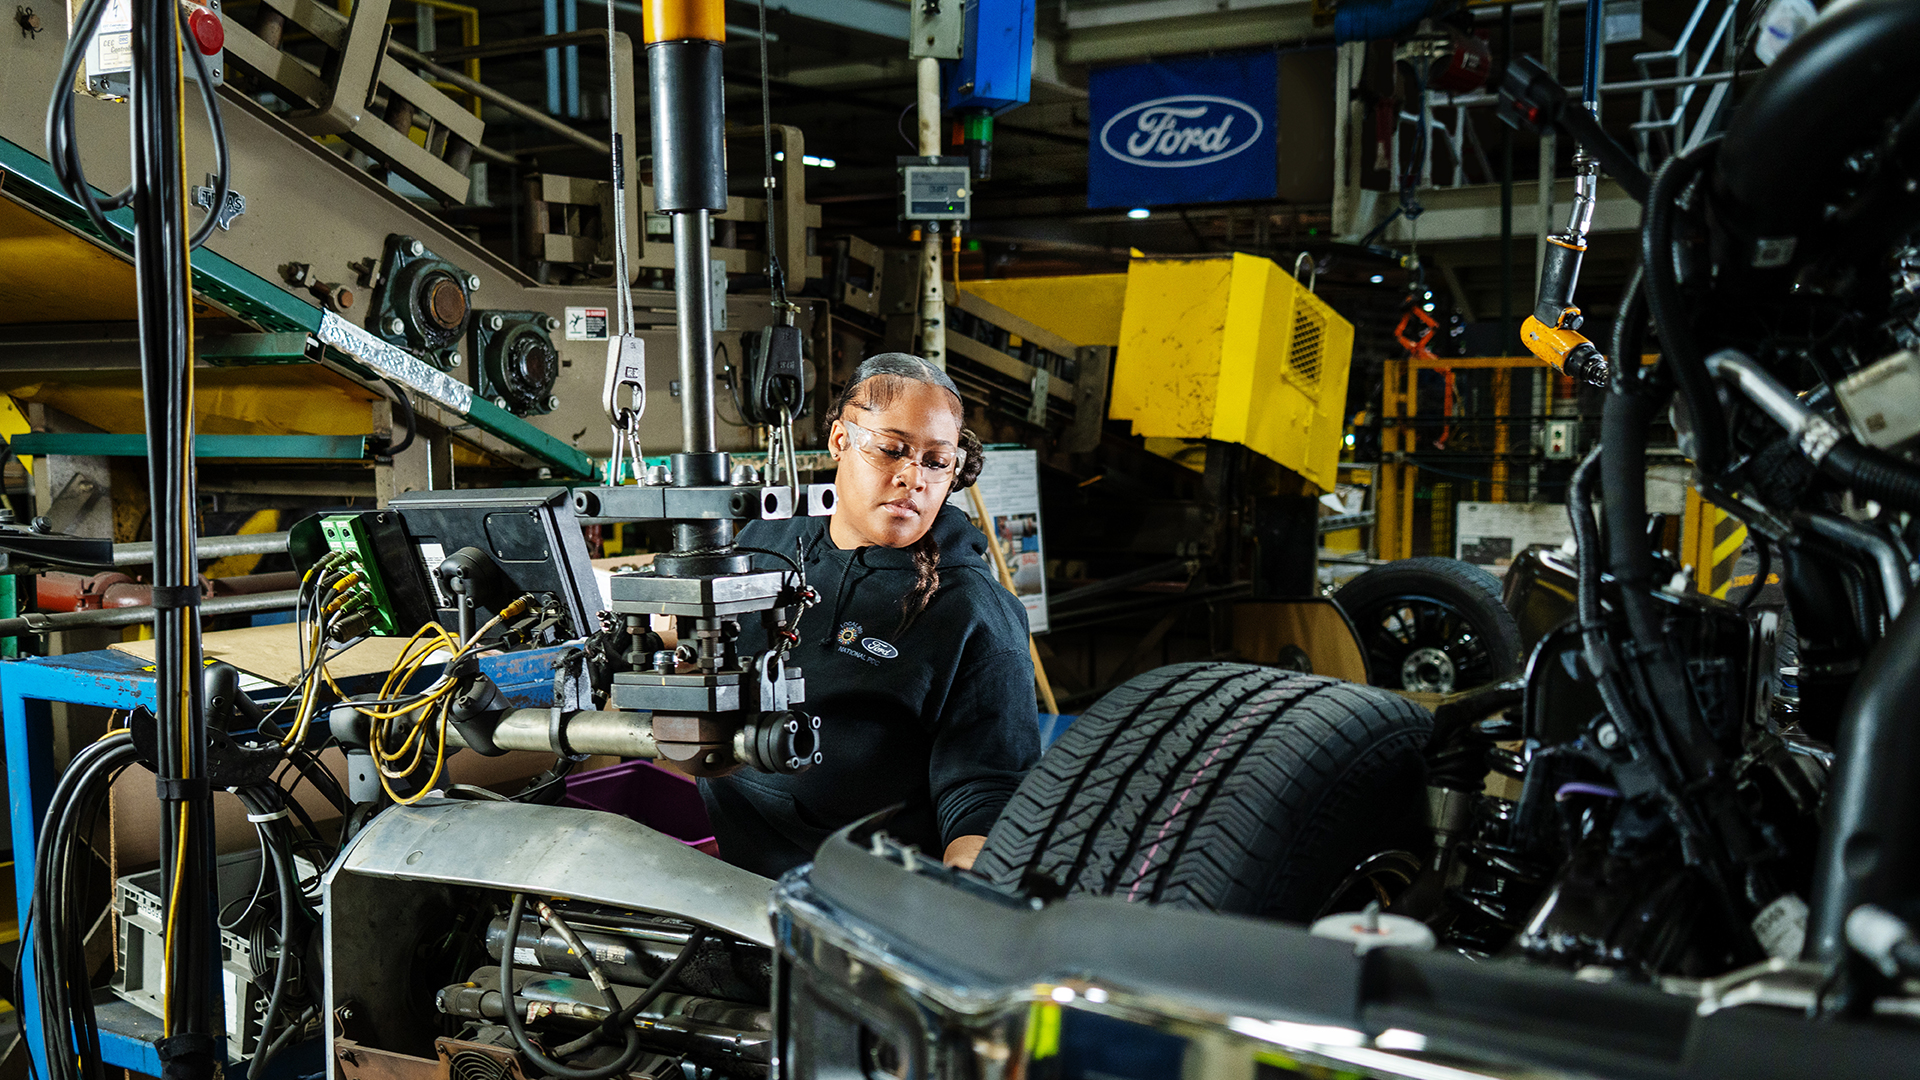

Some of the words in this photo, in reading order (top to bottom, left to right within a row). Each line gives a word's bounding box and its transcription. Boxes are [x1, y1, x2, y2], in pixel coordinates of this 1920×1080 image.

[111, 45, 132, 54] Control
[1127, 105, 1234, 157] Ford
[867, 640, 892, 656] Ford
